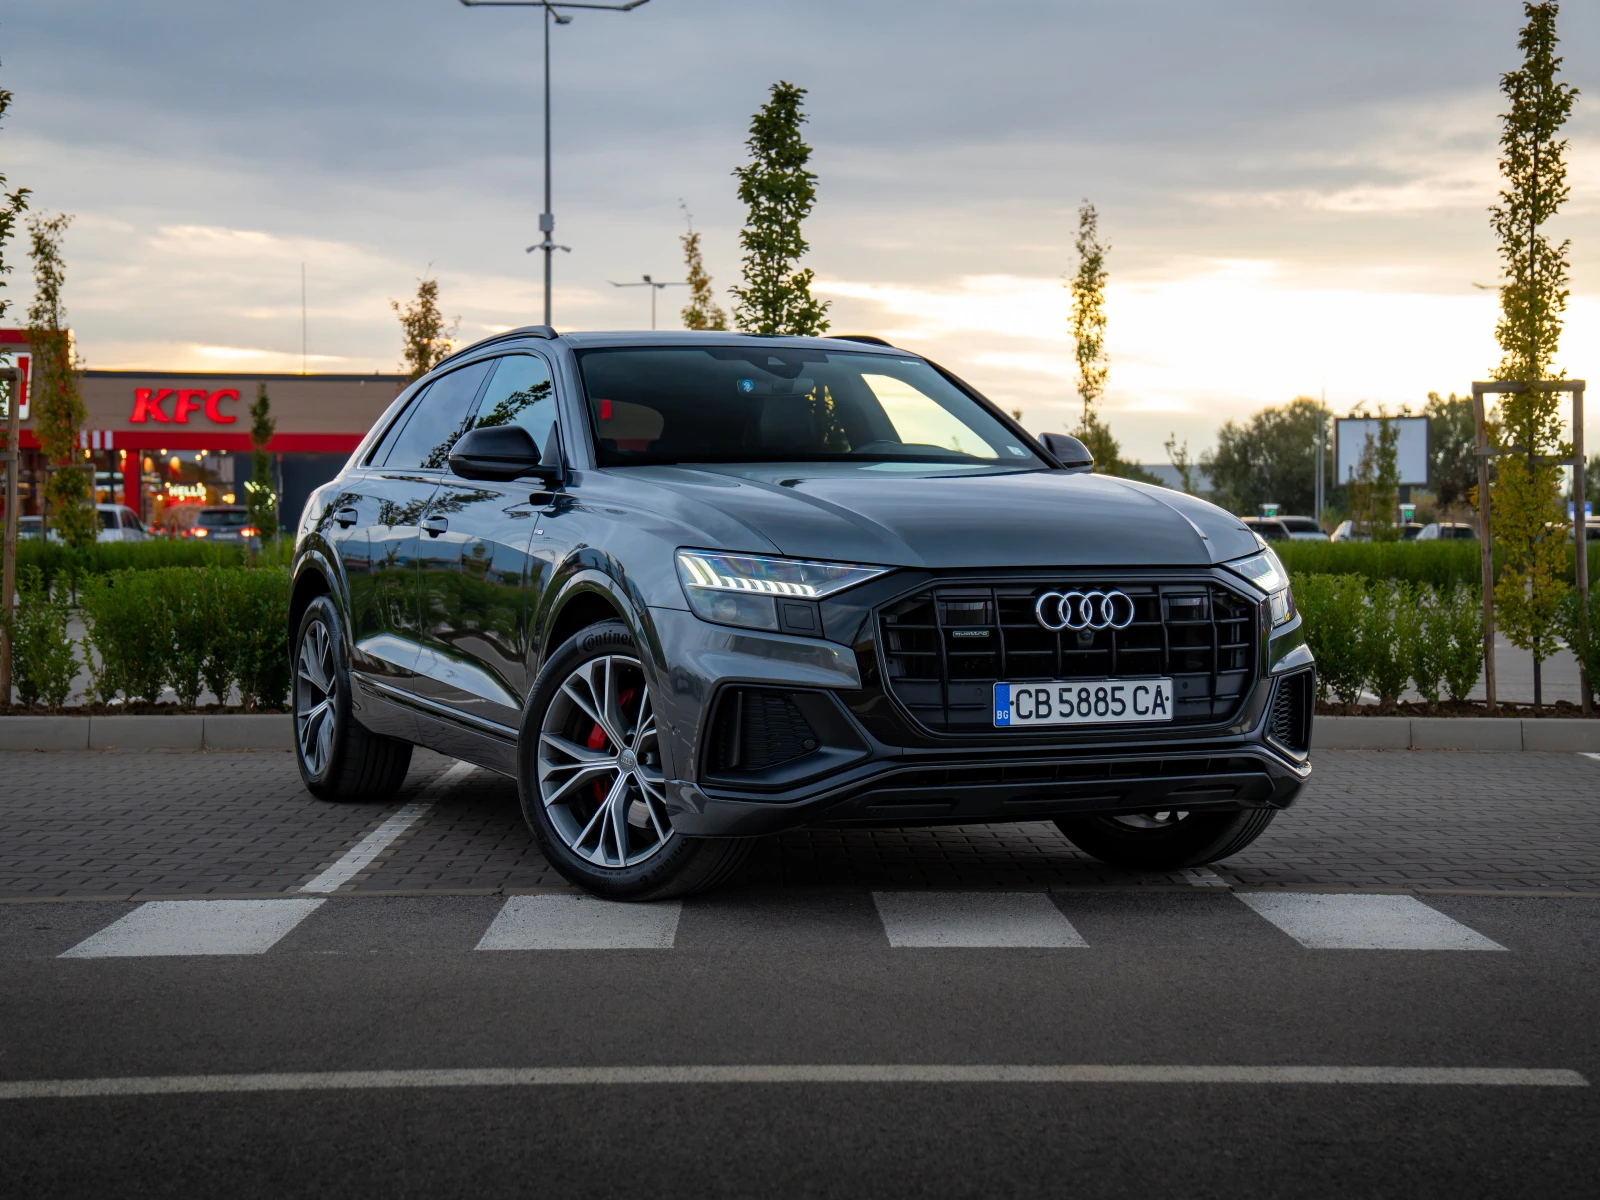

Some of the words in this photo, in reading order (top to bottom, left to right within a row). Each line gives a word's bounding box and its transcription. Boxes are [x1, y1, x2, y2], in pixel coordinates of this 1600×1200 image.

[128, 388, 239, 424] KFC
[168, 485, 207, 497] HELLO
[1015, 688, 1053, 719] CB
[1058, 686, 1127, 718] 5885
[1132, 685, 1167, 715] CA
[996, 710, 1009, 720] BG
